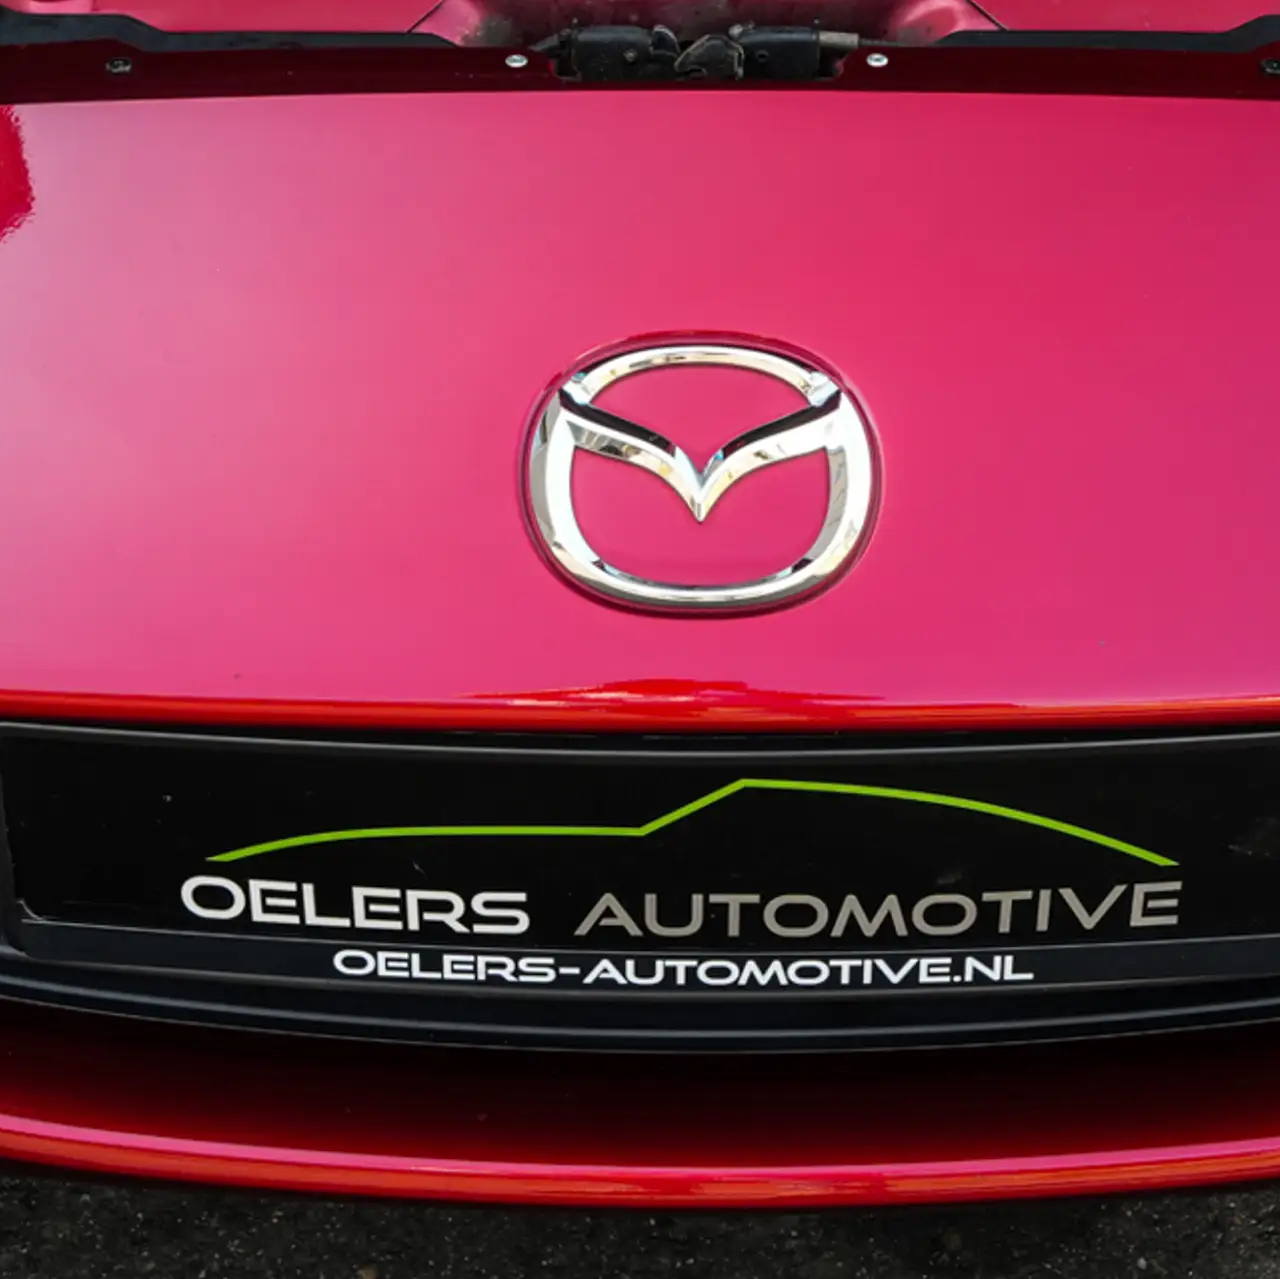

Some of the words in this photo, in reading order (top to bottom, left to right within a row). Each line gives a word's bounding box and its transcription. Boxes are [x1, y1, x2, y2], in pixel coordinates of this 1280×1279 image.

[181, 876, 529, 934] OELERS
[575, 882, 1181, 936] AUTOMOTIVE
[333, 950, 1033, 985] OELERS-AUTOMOTIVE.NL
